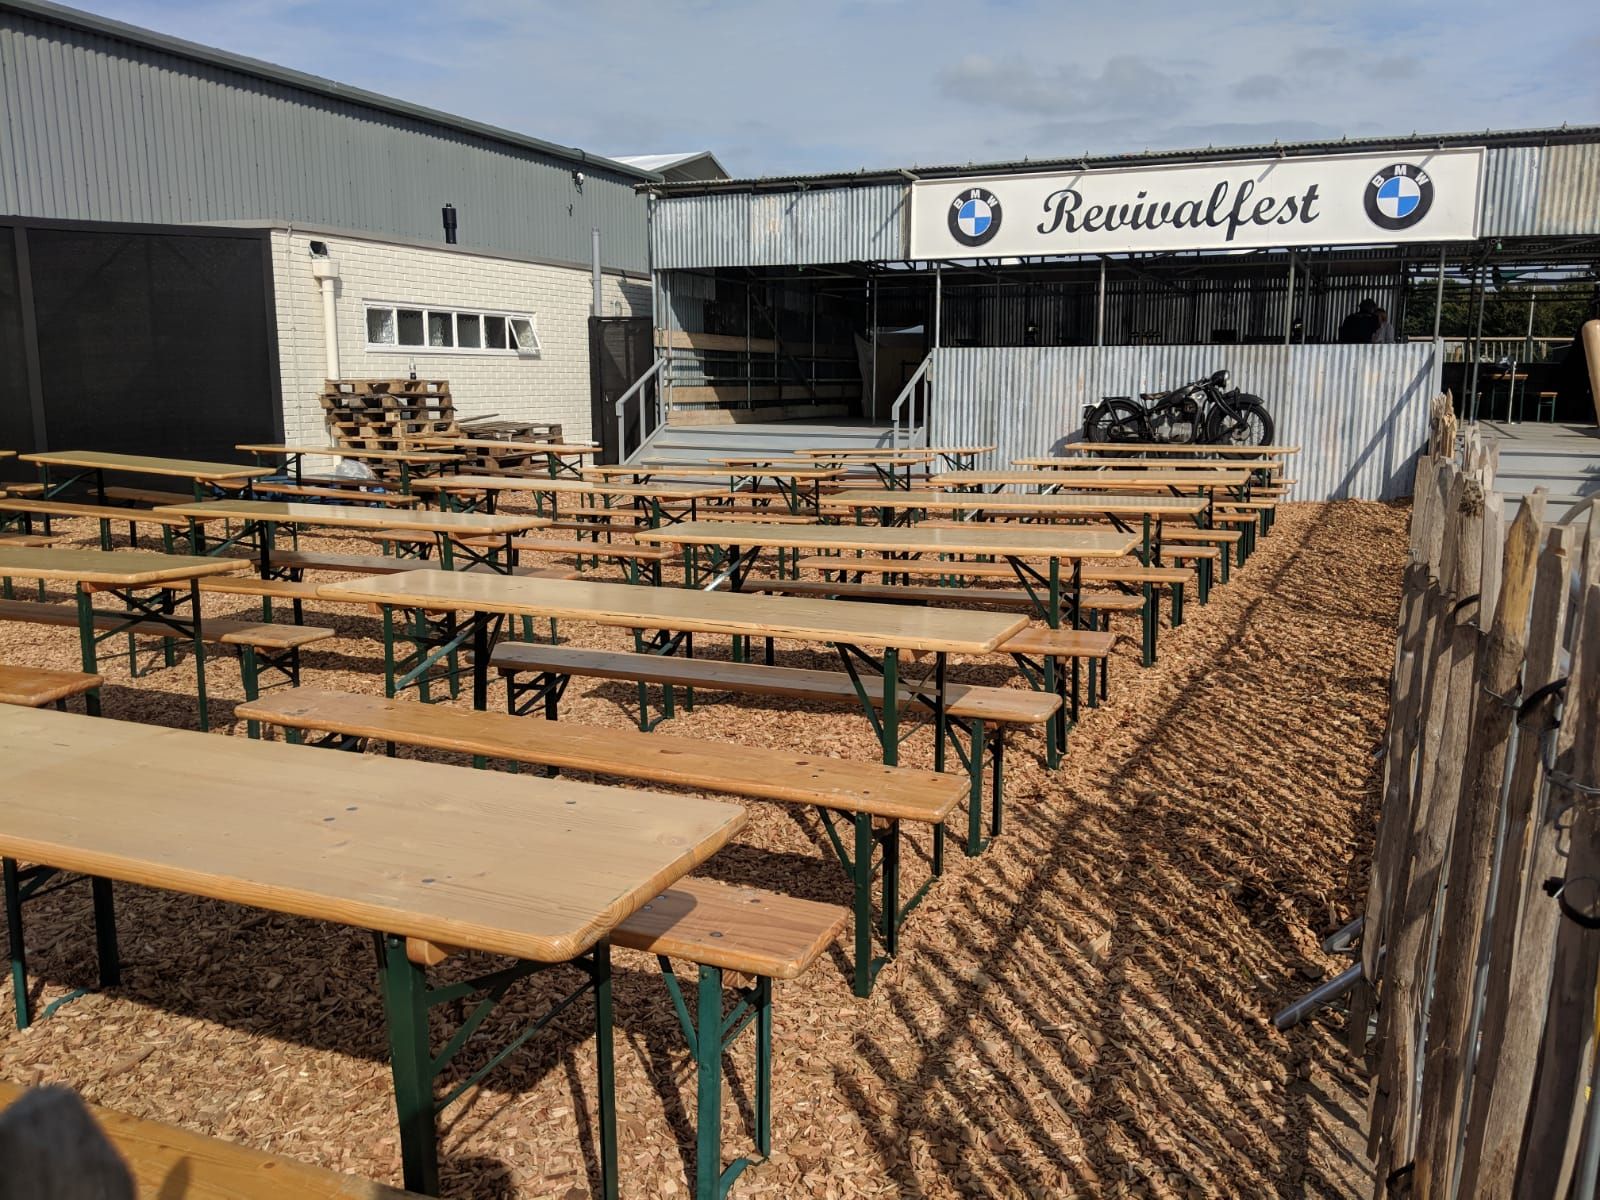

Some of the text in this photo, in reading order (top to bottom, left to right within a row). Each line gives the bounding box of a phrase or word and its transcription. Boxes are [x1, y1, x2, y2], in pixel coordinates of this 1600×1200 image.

[1371, 164, 1429, 188] BMW
[953, 189, 998, 210] BMW
[1037, 179, 1320, 241] Revivalfest
